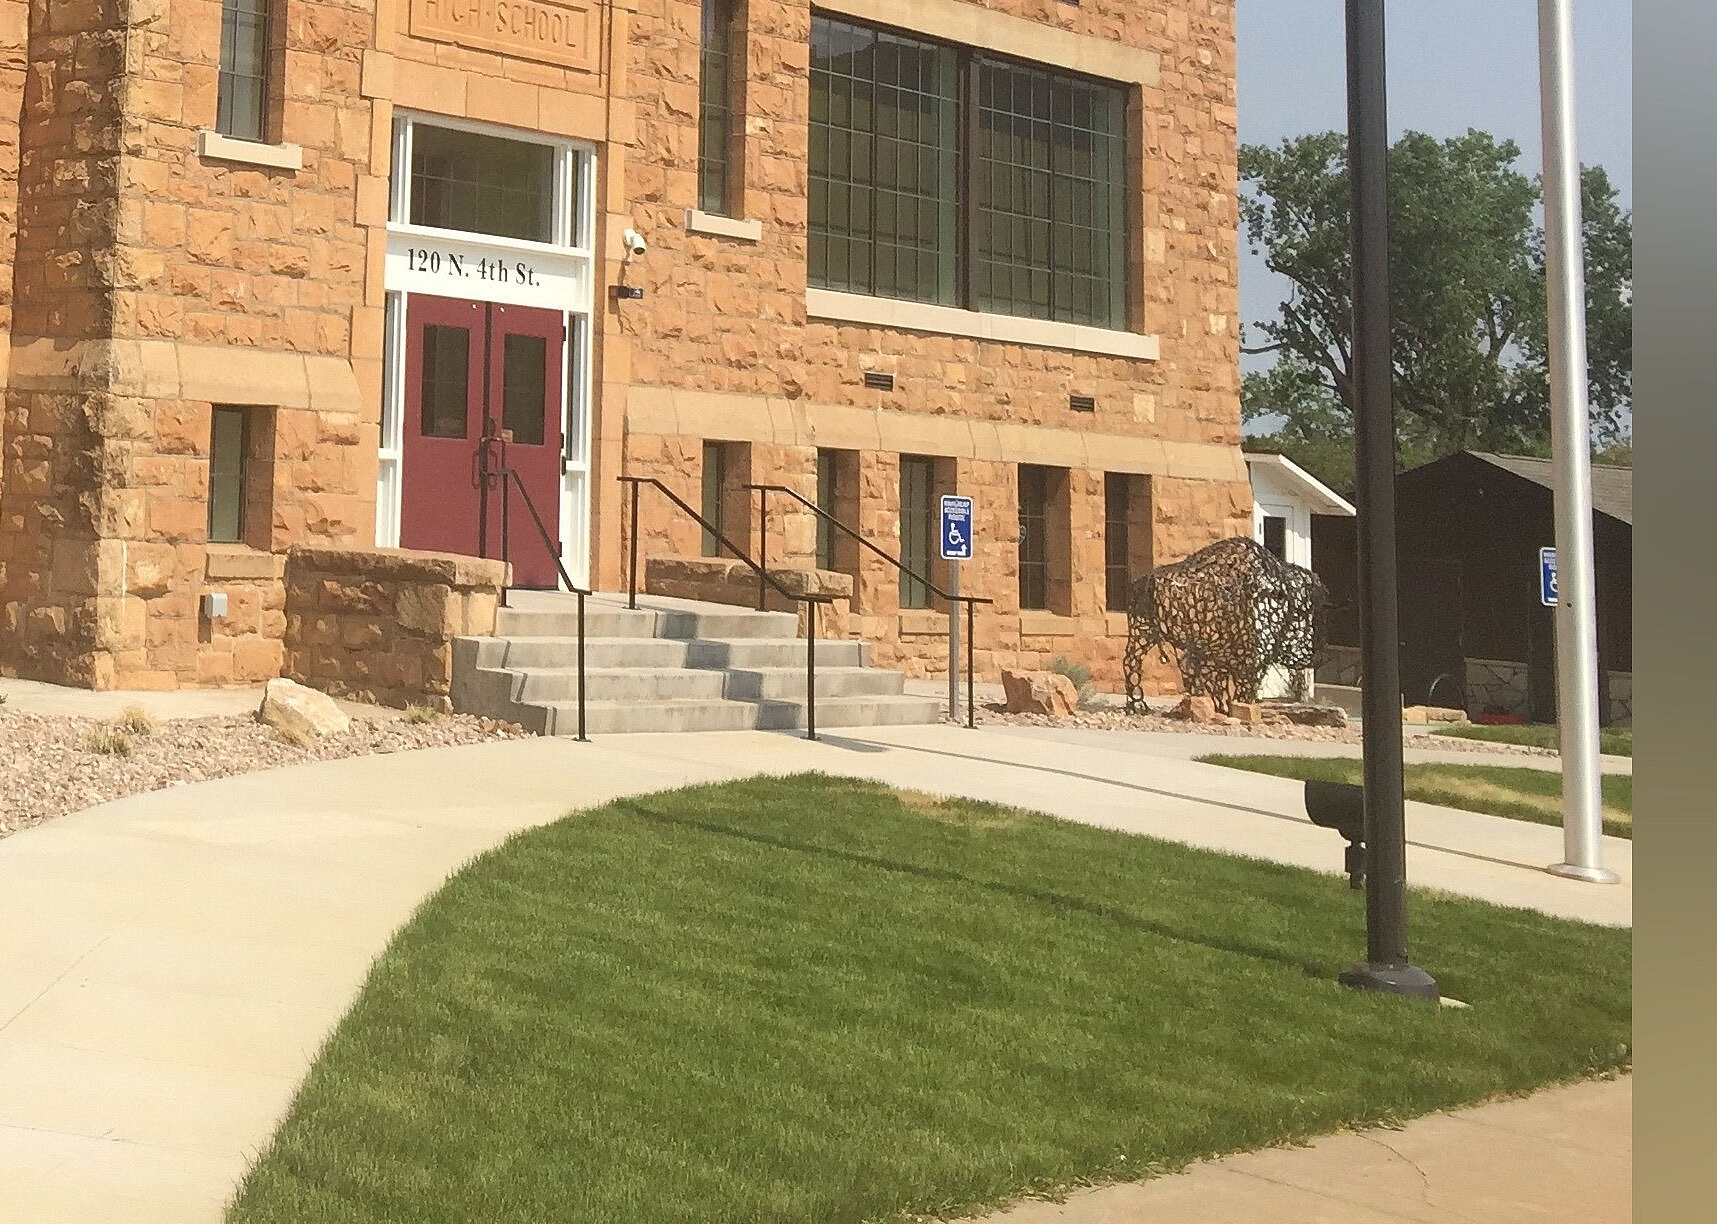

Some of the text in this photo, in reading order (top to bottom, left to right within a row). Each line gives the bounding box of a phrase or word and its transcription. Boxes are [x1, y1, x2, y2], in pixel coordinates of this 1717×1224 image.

[496, 1, 577, 48] SCHOOL
[408, 248, 541, 287] 120 N. 4th St.
